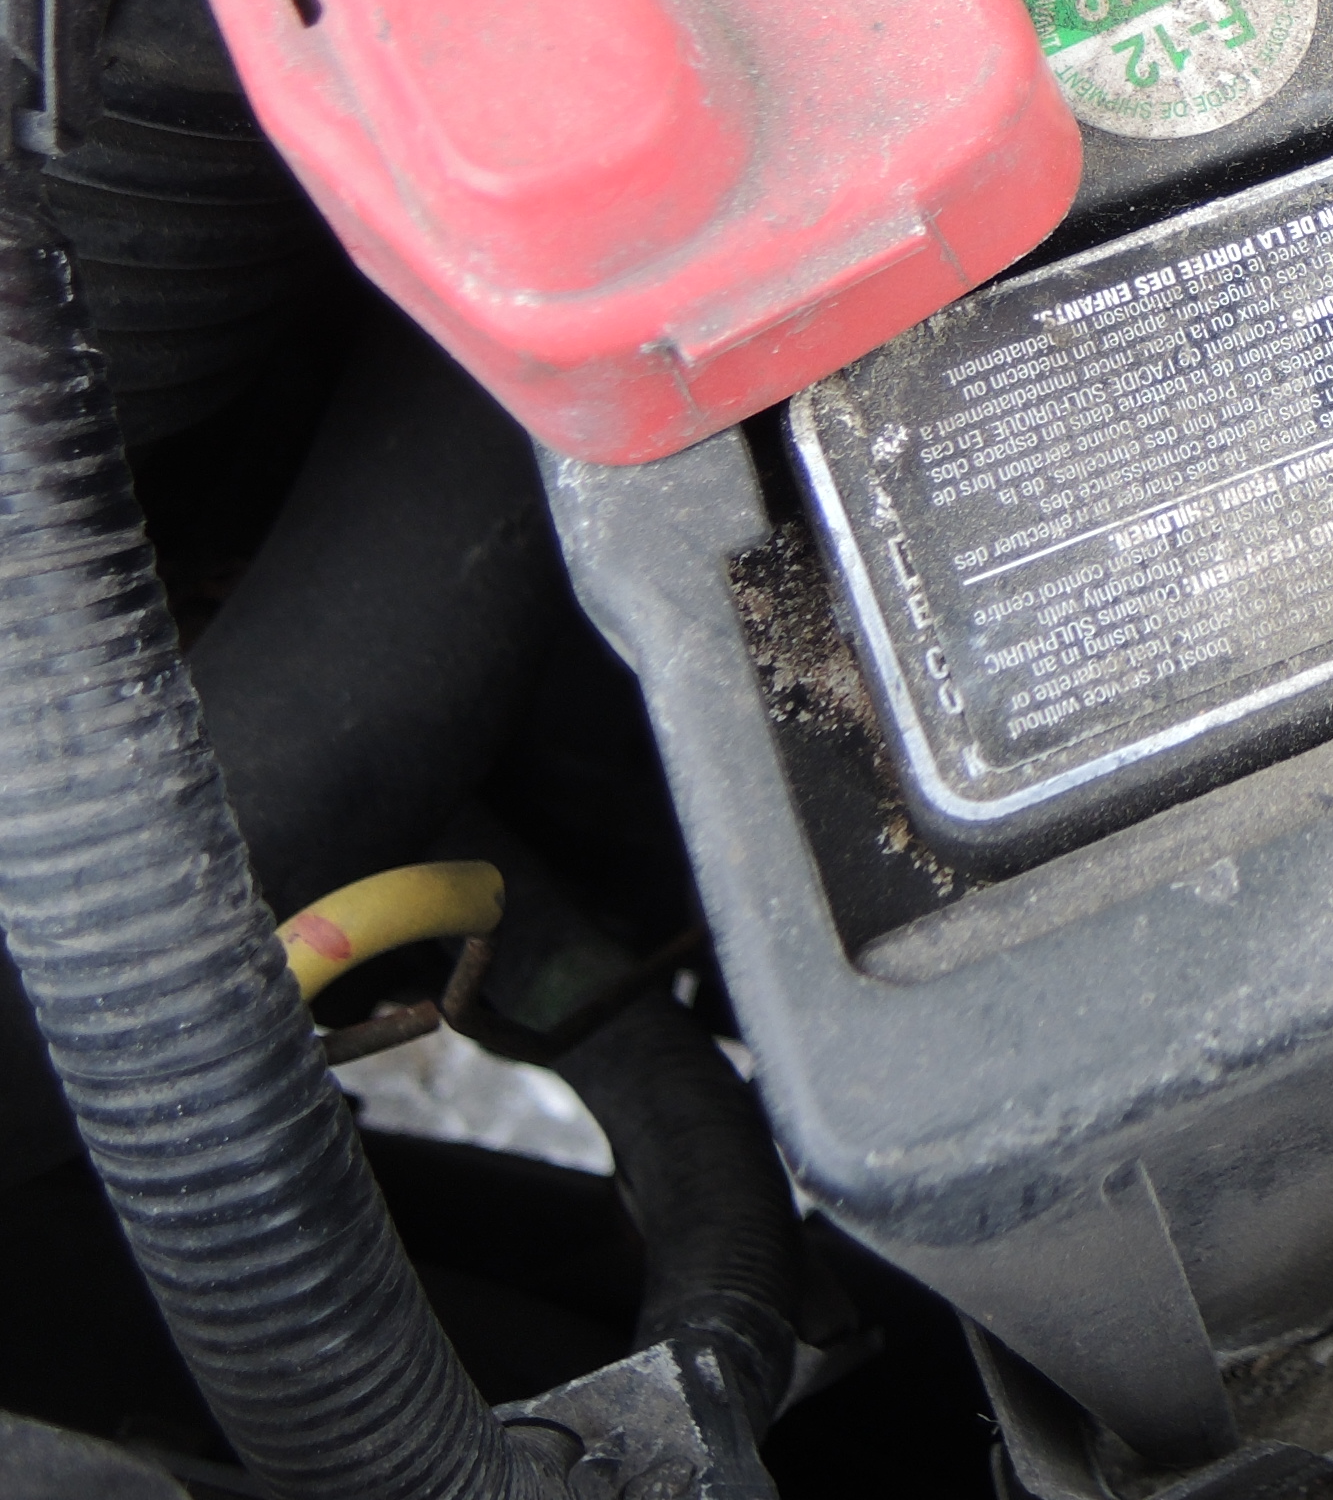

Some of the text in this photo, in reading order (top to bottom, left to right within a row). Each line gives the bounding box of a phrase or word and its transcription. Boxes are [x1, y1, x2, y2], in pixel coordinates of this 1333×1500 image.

[1054, 68, 1150, 117] SHIPMENT
[1160, 99, 1188, 119] DE
[1255, 225, 1286, 251] LA
[1285, 214, 1317, 241] DE
[1245, 254, 1265, 275] le
[1266, 237, 1310, 264] avec
[1133, 265, 1176, 296] DES
[1274, 261, 1309, 285] cas
[1089, 279, 1185, 332] antipoison
[1071, 339, 1097, 360] un
[1095, 309, 1169, 353] appeler
[1203, 319, 1278, 361] contient
[935, 291, 1280, 438] yeux ou la rincer immédiatement
[989, 350, 1070, 393] médecin
[1107, 357, 1176, 397] l'ACIDE
[1188, 367, 1209, 389] la
[1209, 357, 1236, 381] de
[961, 380, 987, 400] ou
[1116, 375, 1188, 416] batterie
[984, 383, 1107, 443] SULFURIQUE.
[1040, 420, 1066, 441] un
[1068, 403, 1115, 434] dans
[919, 439, 955, 464] cas
[930, 405, 1170, 510] une bonne lors de
[957, 429, 984, 453] En
[969, 427, 1038, 467] espace
[997, 393, 1264, 508] Tenir loin des de la
[1038, 393, 1323, 517] sans prendre connaissance des
[924, 457, 971, 488] clos.
[1216, 471, 1280, 511] FROM
[953, 452, 1219, 575] pas charger des
[1107, 496, 1216, 554] CHILDREN.
[971, 528, 1195, 630] or poison control centre
[1035, 509, 1304, 630] or thoroughly with
[982, 582, 1181, 674] Contains SULPHURIC
[1030, 614, 1164, 678] or using in an
[1005, 636, 1231, 740] boost or service without
[1007, 652, 1118, 711] cigarette or
